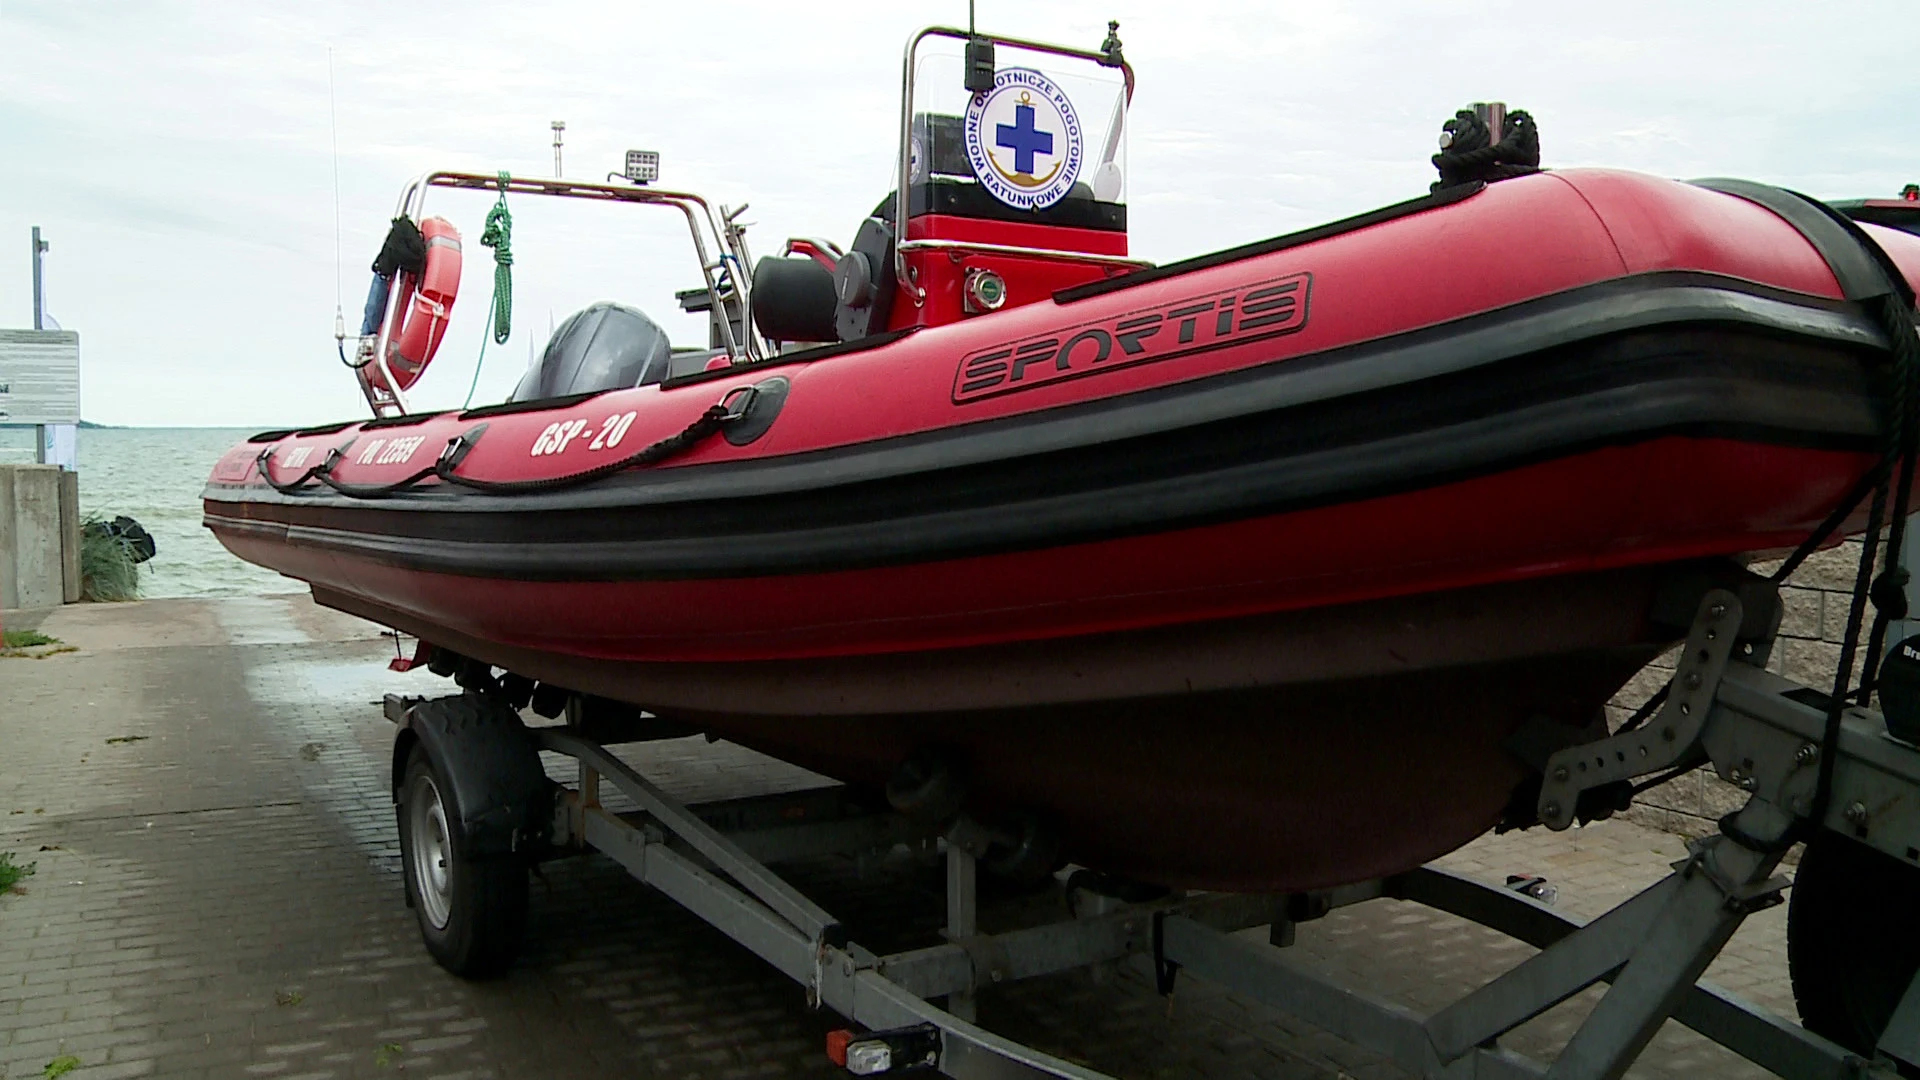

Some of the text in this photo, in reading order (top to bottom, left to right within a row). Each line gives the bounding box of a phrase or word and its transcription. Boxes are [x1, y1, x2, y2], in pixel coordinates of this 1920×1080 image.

[968, 72, 1080, 207] WODNE OCOTNICZE POGOTOWIE RATUNKOWE
[961, 281, 1300, 394] SPORTIS
[530, 410, 638, 457] GSP-20
